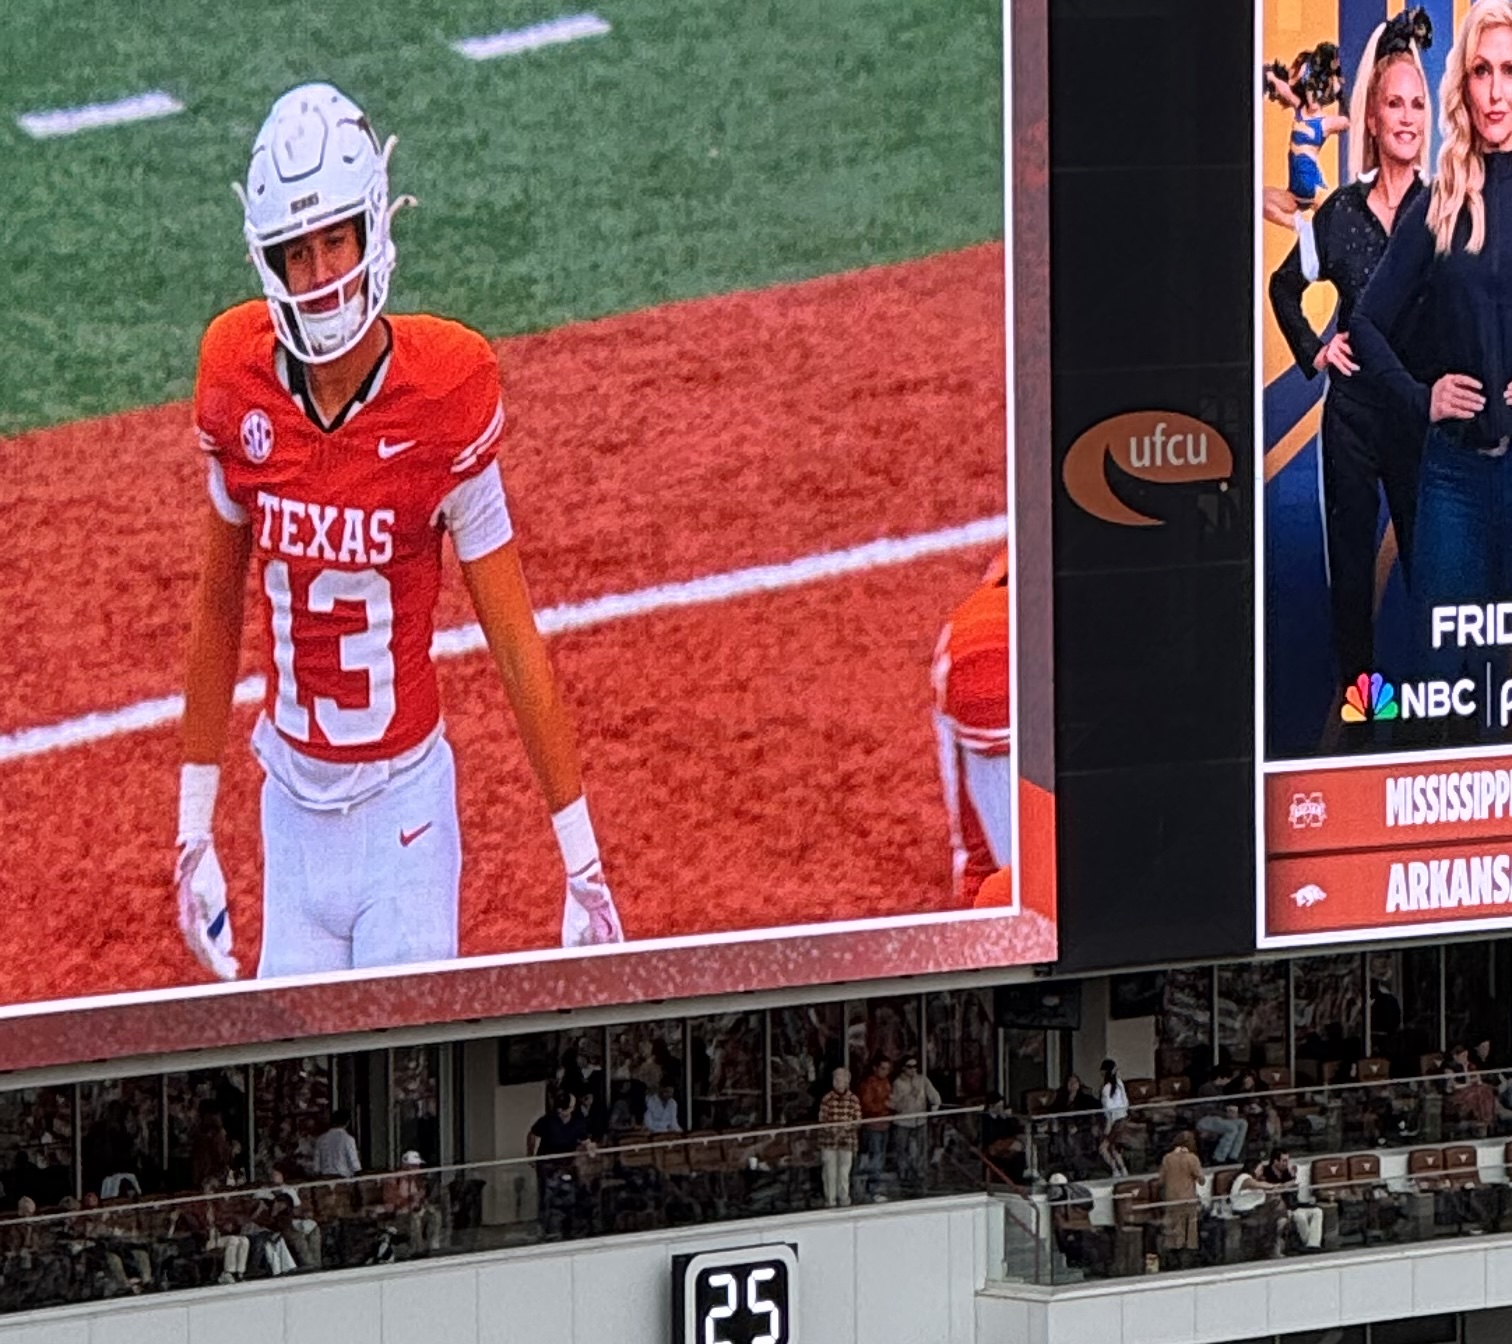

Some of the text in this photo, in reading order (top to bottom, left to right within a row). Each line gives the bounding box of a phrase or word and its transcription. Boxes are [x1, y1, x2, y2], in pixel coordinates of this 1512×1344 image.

[1129, 422, 1208, 468] ufcu
[256, 491, 396, 565] TEXAS
[264, 559, 397, 747] 13
[1401, 678, 1477, 720] NBC
